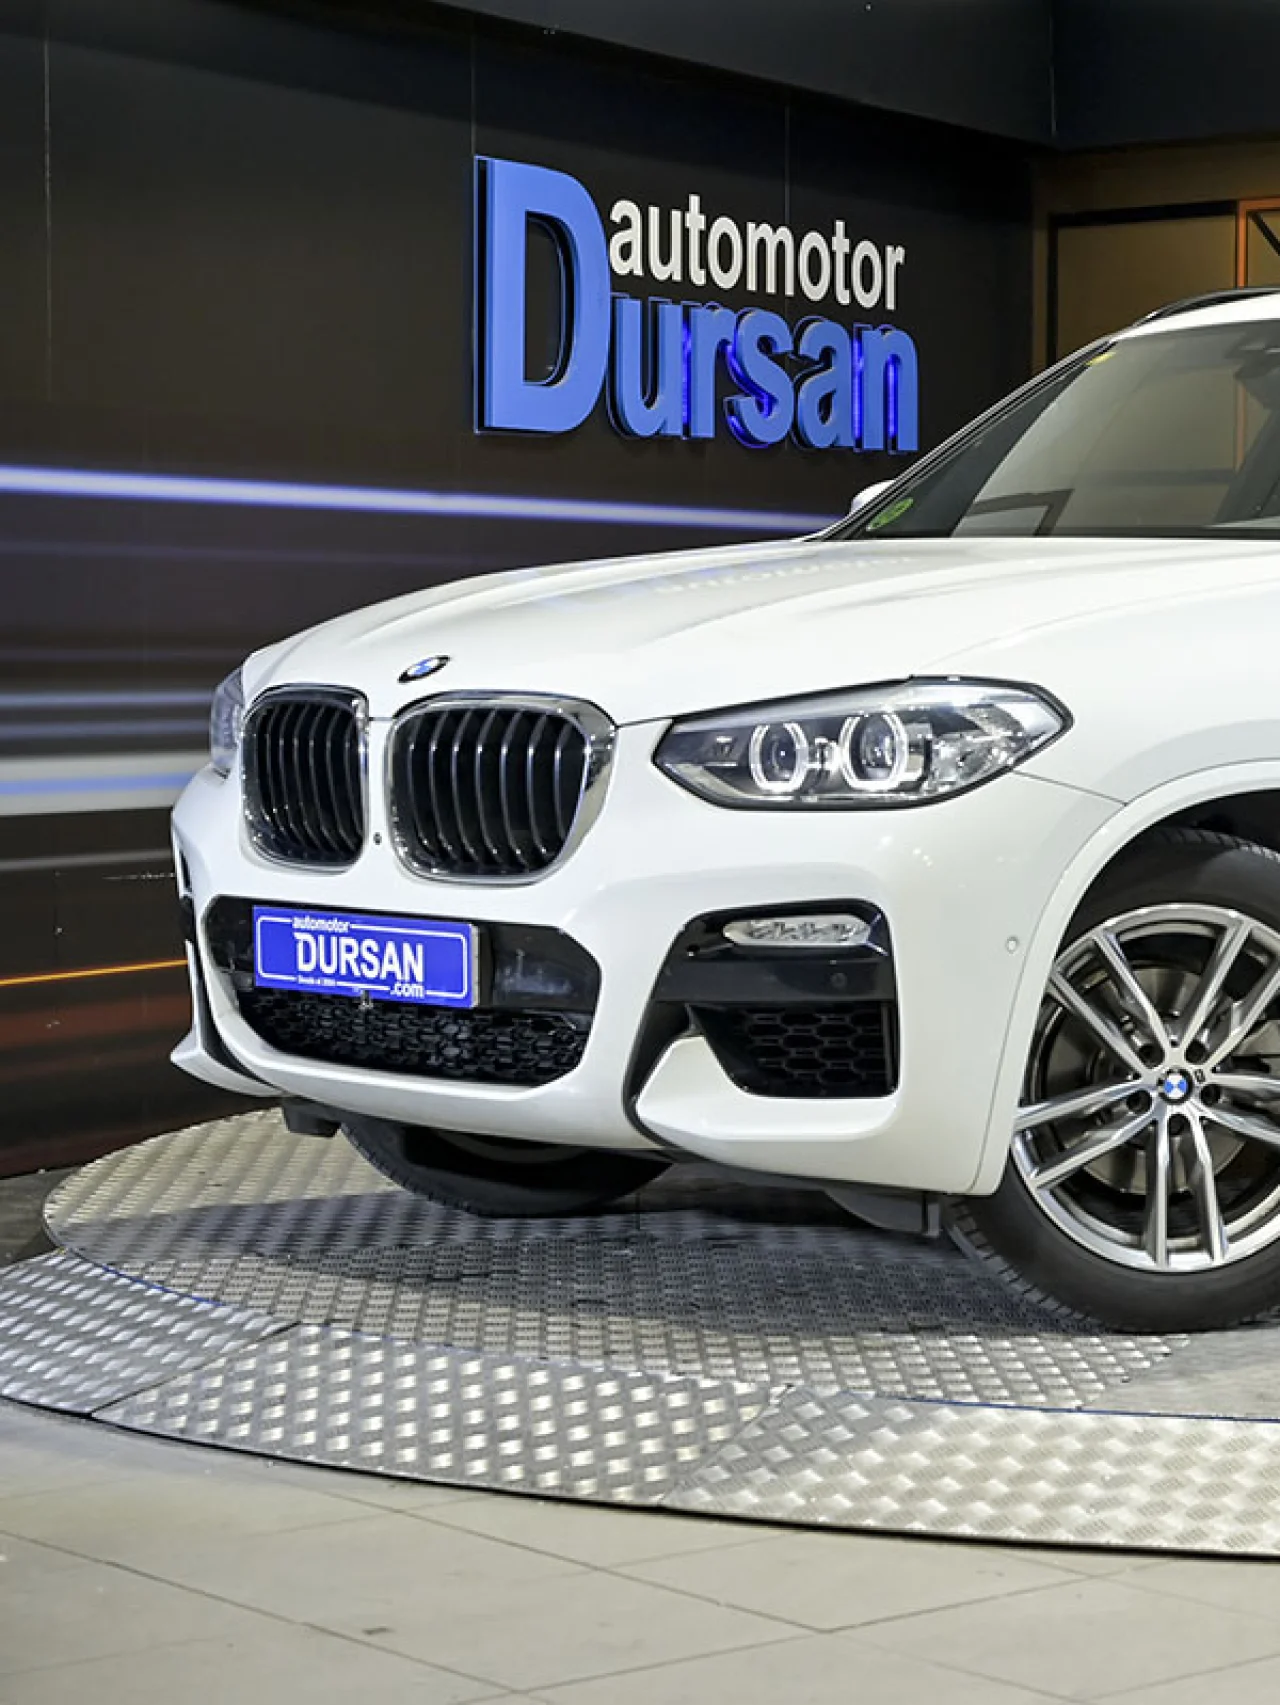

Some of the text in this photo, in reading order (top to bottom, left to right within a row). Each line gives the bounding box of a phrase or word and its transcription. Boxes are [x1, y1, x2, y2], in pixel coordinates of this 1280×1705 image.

[609, 194, 905, 310] automotor
[475, 156, 918, 454] Dursan
[292, 916, 350, 933] automotor
[294, 932, 424, 983] DURSAN
[391, 981, 425, 998] .com
